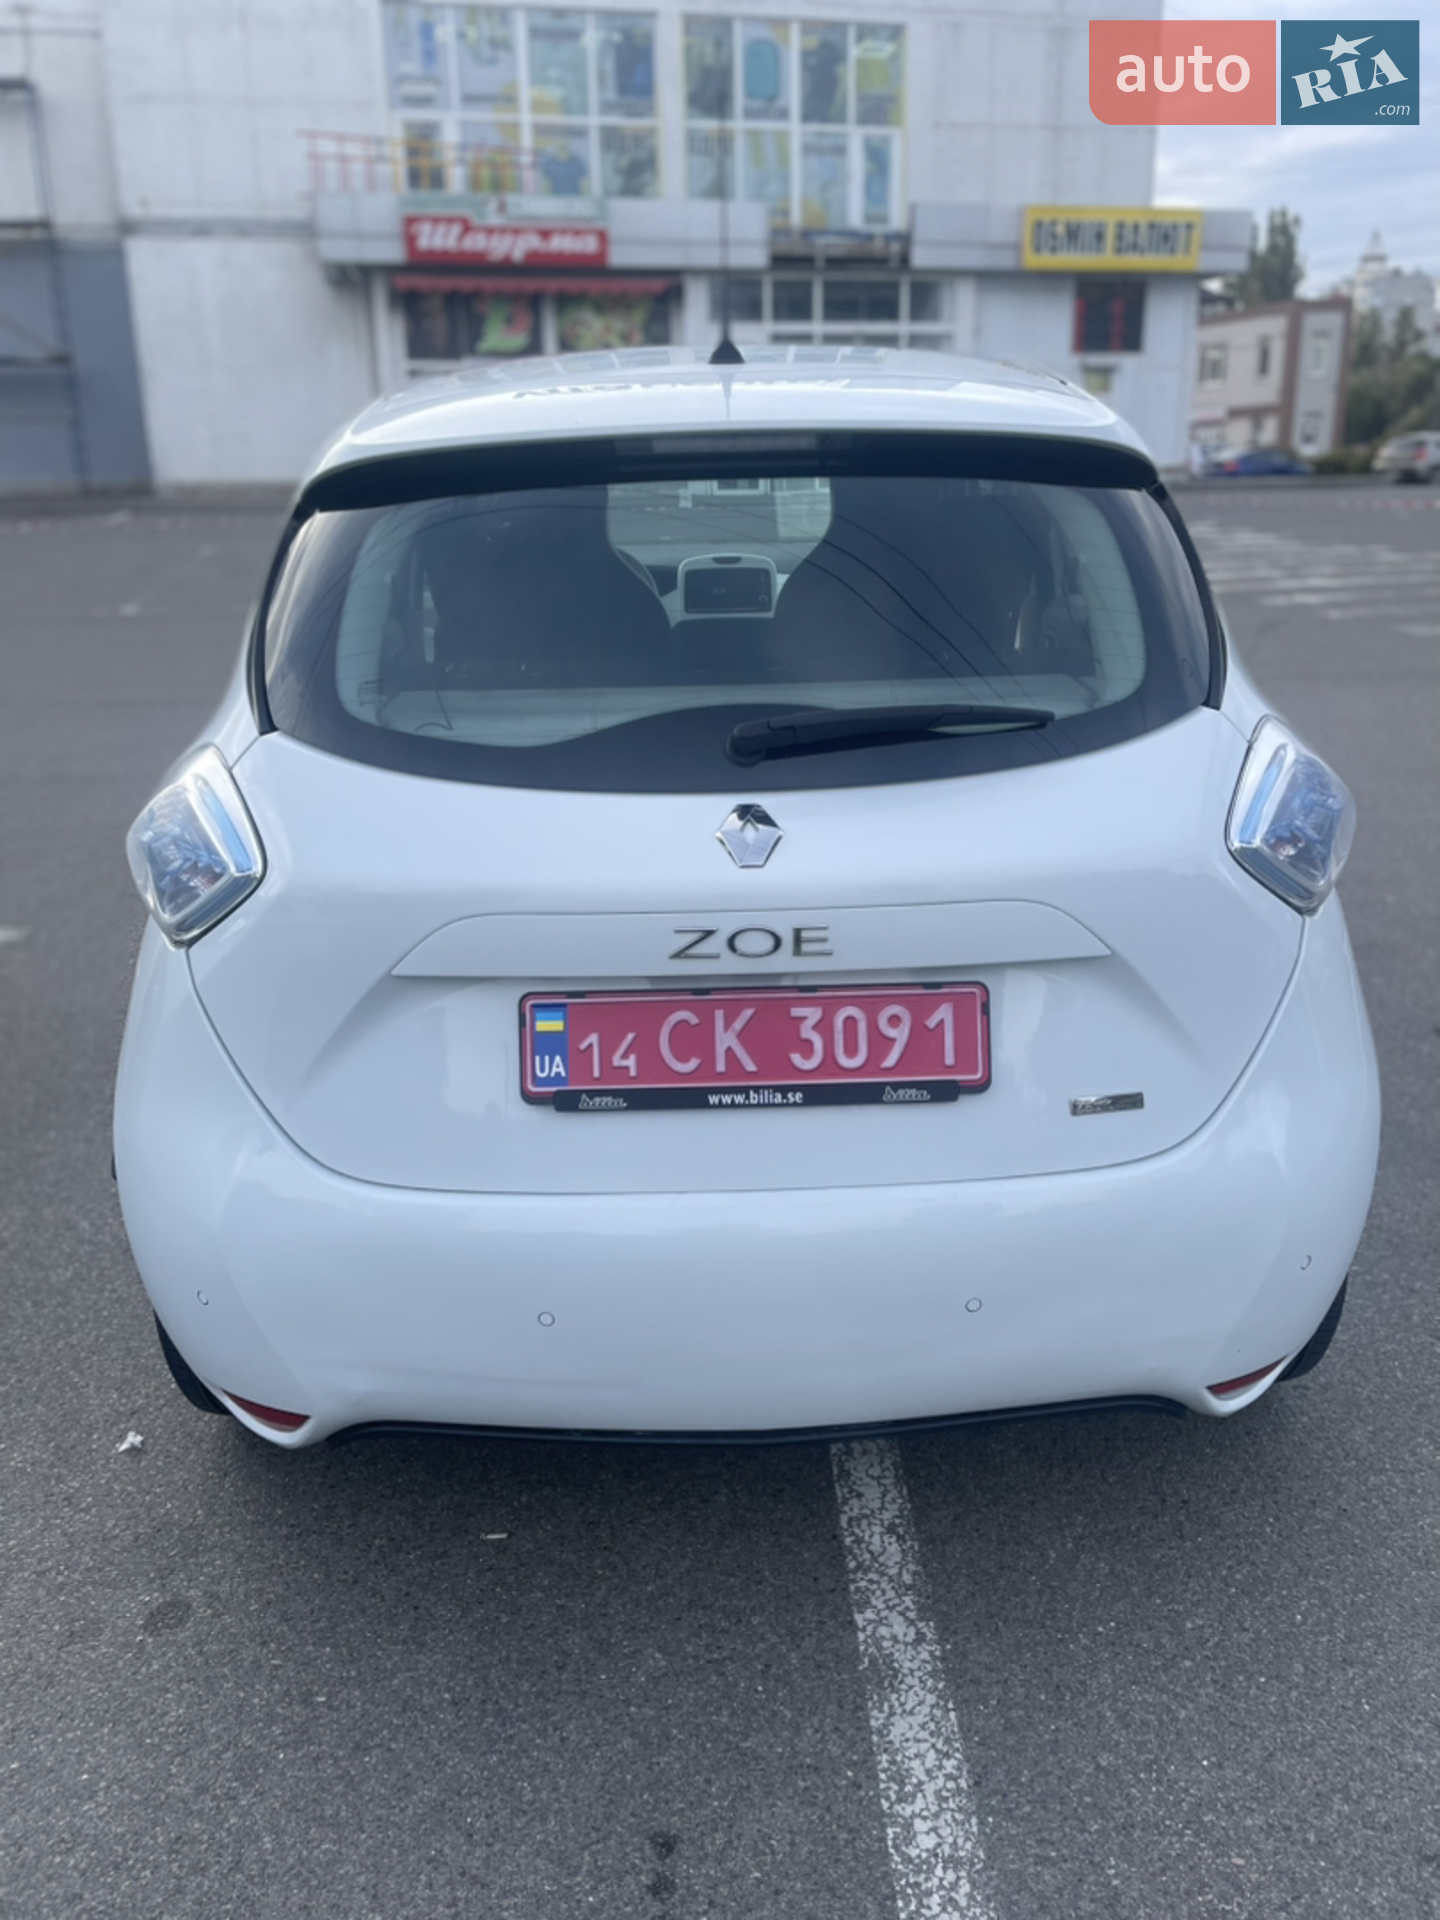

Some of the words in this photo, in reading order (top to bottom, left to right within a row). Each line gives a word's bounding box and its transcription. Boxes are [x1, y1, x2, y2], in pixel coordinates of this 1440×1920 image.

[1034, 219, 1107, 256] ОБМІН
[1113, 220, 1193, 257] ВАЛЮТ
[669, 925, 833, 959] ZOE
[578, 1033, 637, 1077] 14
[659, 1009, 757, 1074] CK
[790, 1003, 956, 1072] 3091
[535, 1054, 566, 1078] UA
[708, 1089, 803, 1107] www.bilia.se
